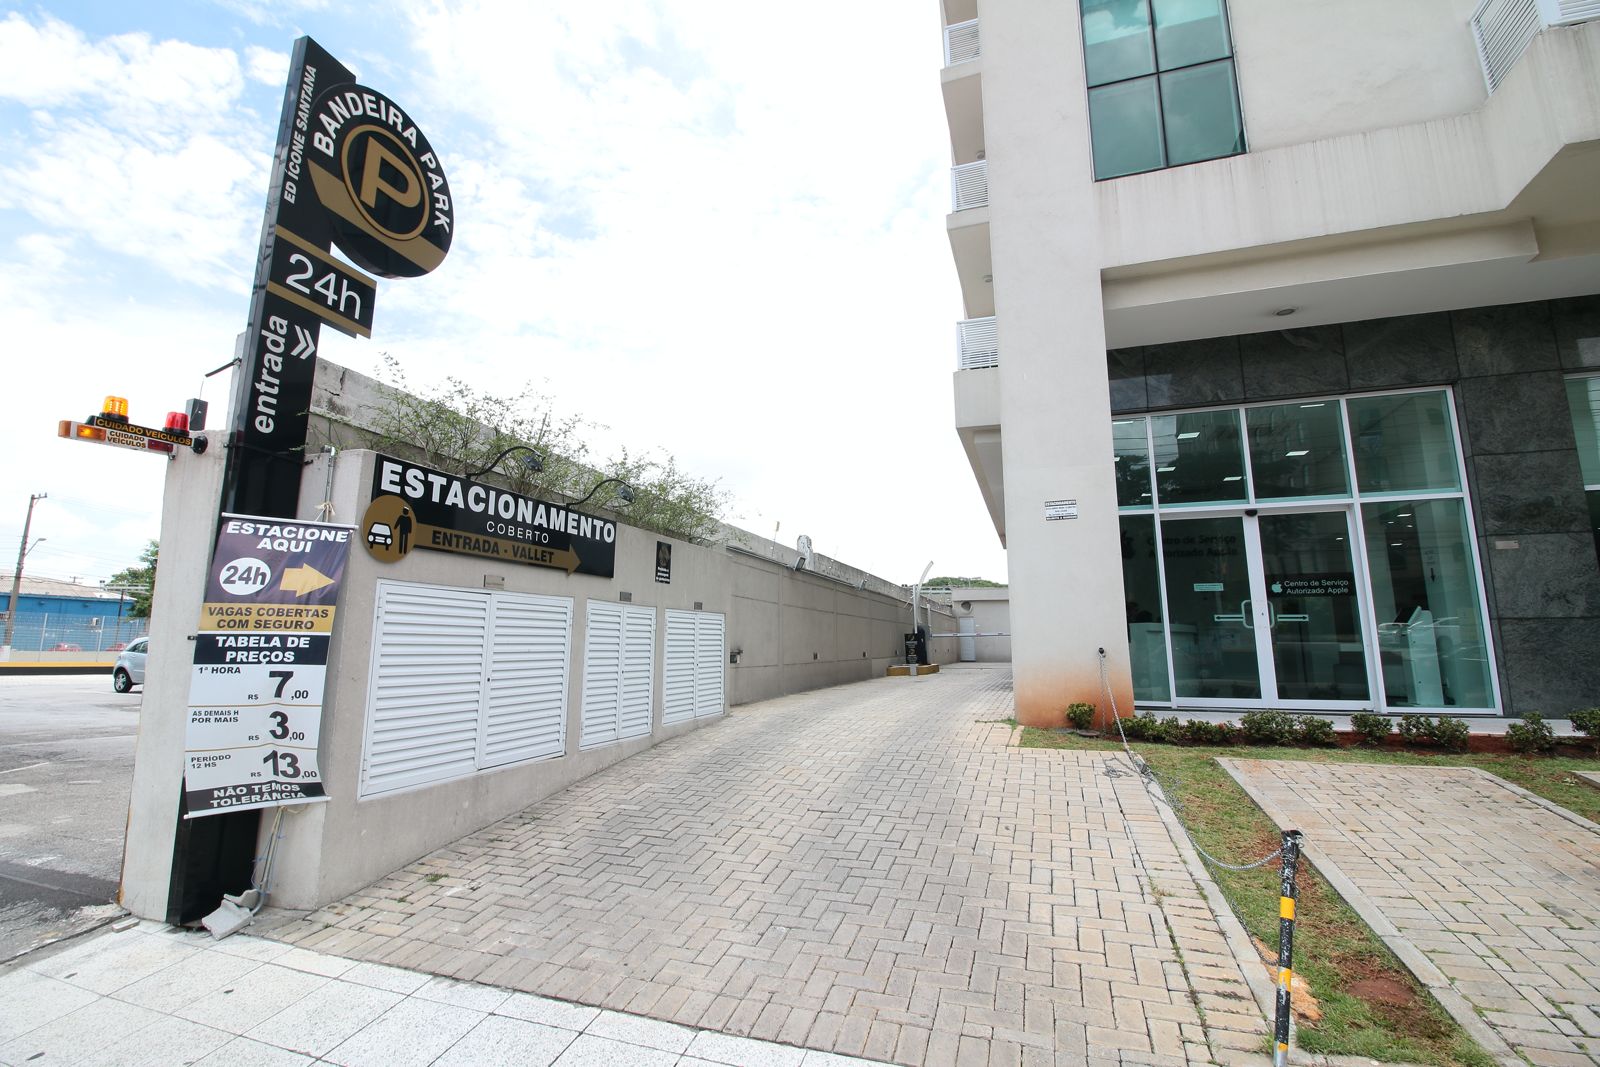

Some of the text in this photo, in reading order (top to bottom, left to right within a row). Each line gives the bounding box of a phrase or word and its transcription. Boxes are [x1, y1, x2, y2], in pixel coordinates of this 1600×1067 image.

[284, 184, 297, 204] ED
[297, 65, 317, 131] SANTANA
[313, 92, 450, 234] BANDEIRA PARK
[360, 135, 422, 208] P
[285, 253, 361, 320] 24h
[255, 315, 289, 434] entrada
[97, 418, 192, 446] CUIDADO VEÍCULOS
[107, 430, 147, 449] CUIDADO VEÍCULOS
[381, 461, 616, 543] ESTACIONAMENTO
[226, 521, 349, 543] ESTACIONE
[486, 520, 550, 544] COBERTO
[256, 538, 313, 553] AQUI
[431, 530, 500, 556] ENTRADA
[512, 544, 555, 564] VALLET
[222, 565, 268, 586] 24h
[1327, 587, 1349, 595] Apple
[208, 606, 329, 618] VAGAS COBERTAS
[217, 619, 315, 630] COM SEGURO
[216, 636, 311, 648] TABELA DE
[225, 651, 295, 665] PREÇOS
[204, 709, 232, 717] DEMAIS
[210, 791, 307, 808] TOLERÂNCIA
[213, 782, 301, 798] NÃO TEMOS
